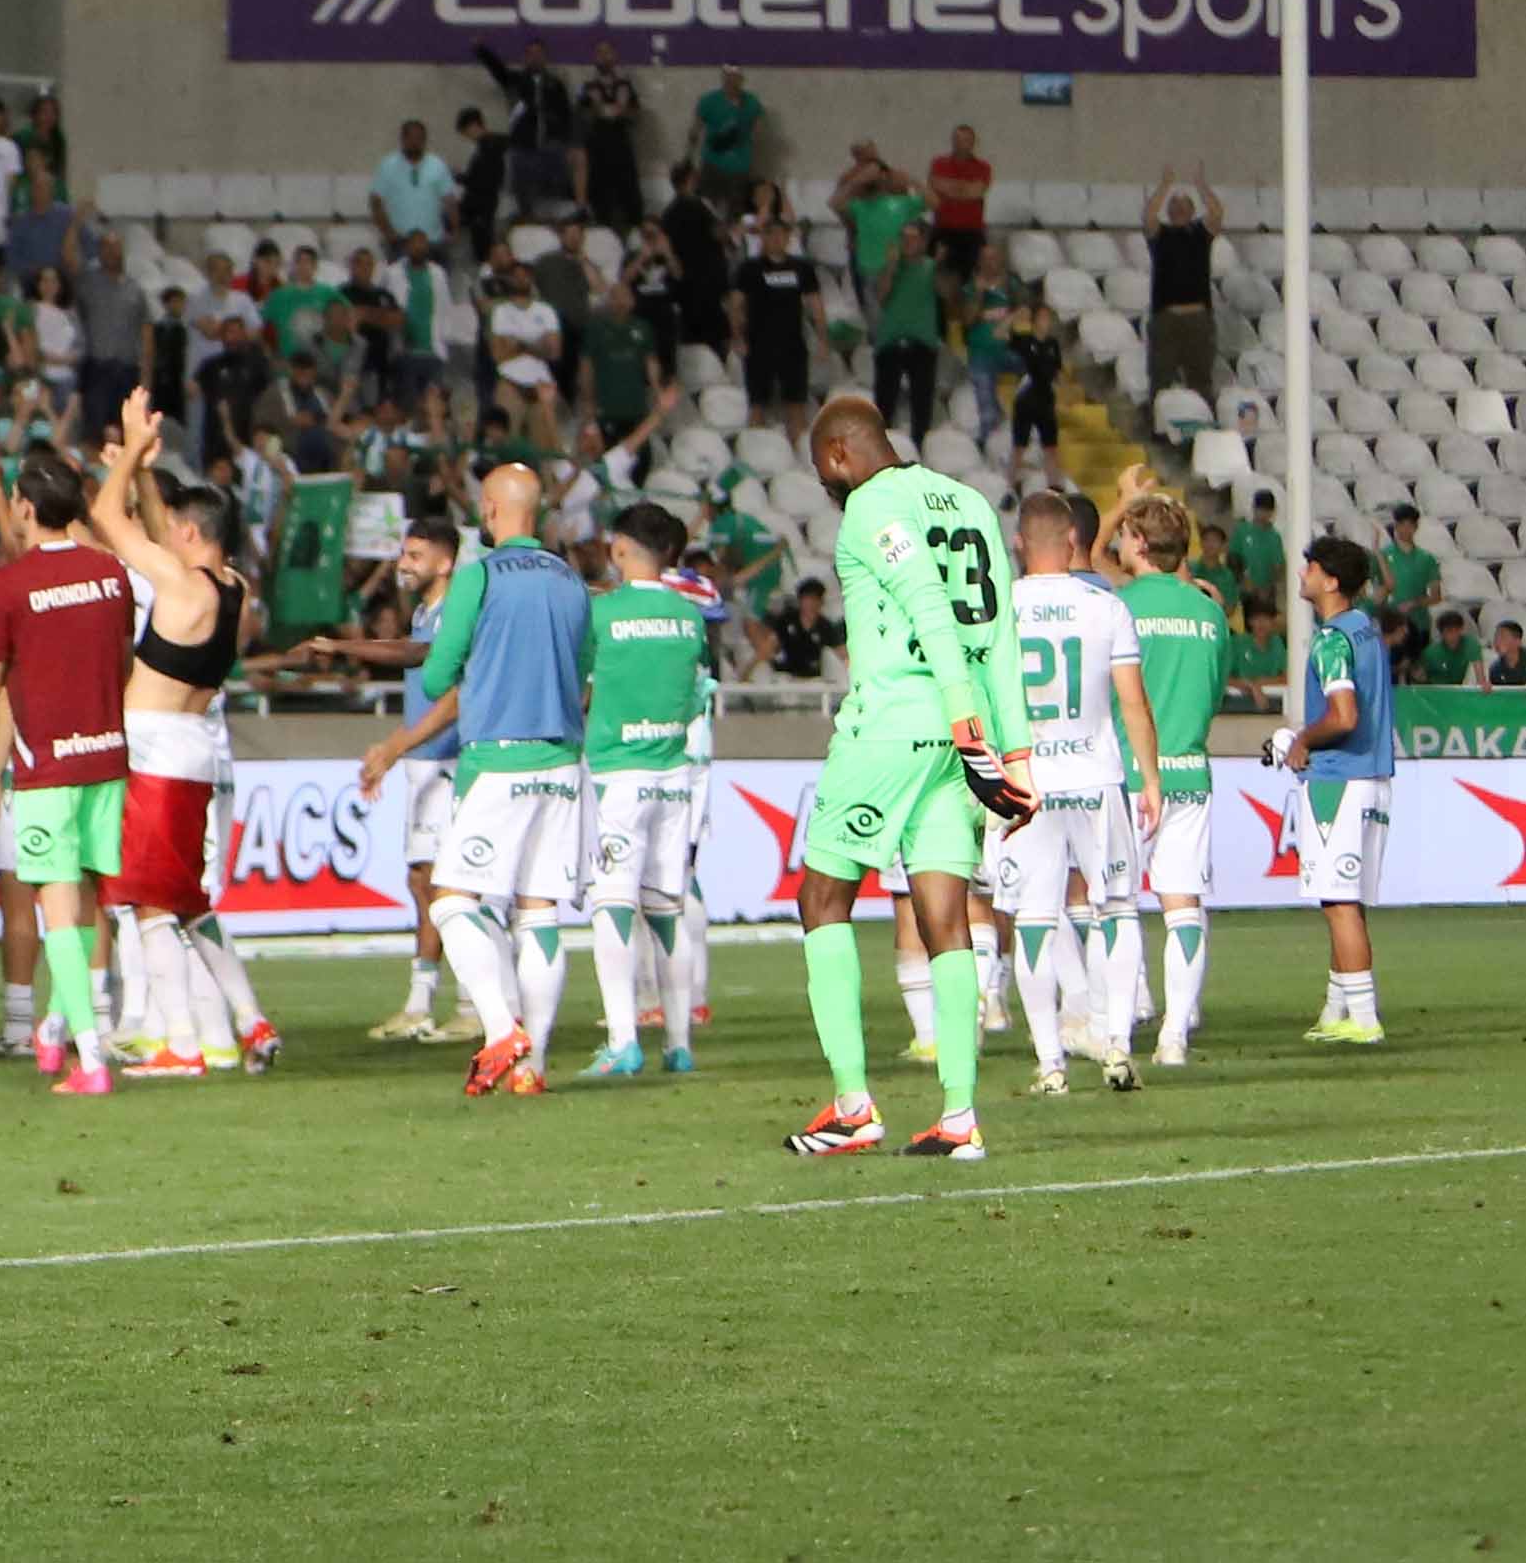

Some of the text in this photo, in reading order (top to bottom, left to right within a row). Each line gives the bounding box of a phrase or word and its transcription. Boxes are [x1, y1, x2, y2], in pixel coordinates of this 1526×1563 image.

[29, 577, 122, 613] OMONOIA FC
[1031, 604, 1077, 623] SIMIC
[611, 617, 698, 641] OMONOIA FC
[1136, 617, 1218, 641] OMONOIA FC
[1021, 635, 1082, 721] 21
[1038, 790, 1104, 813] rimetel
[233, 783, 373, 885] ACS
